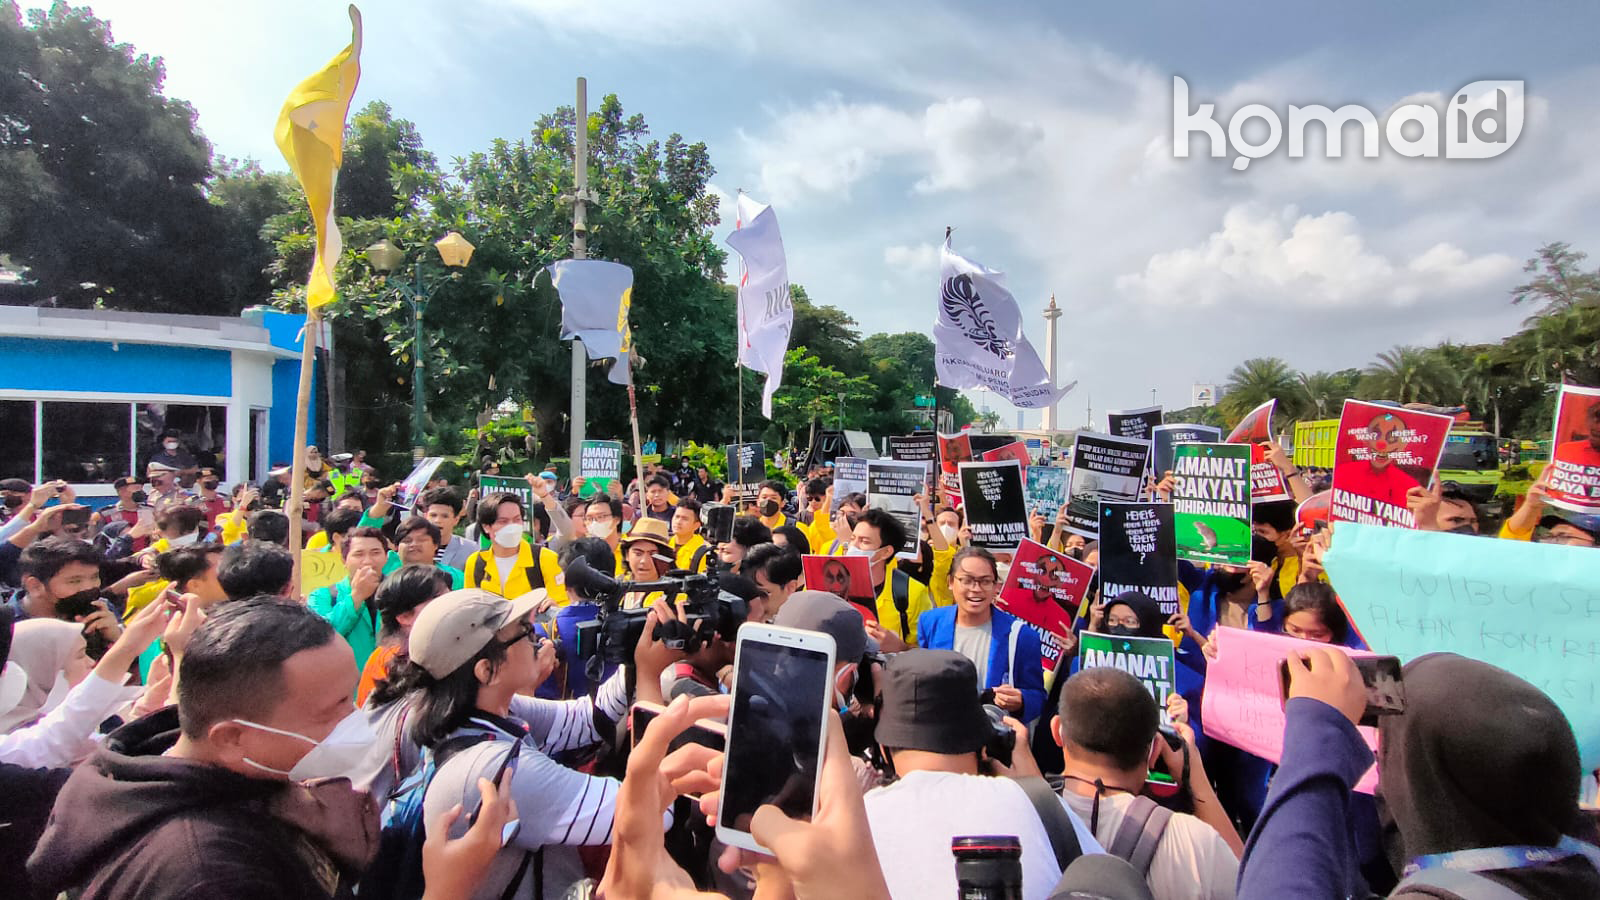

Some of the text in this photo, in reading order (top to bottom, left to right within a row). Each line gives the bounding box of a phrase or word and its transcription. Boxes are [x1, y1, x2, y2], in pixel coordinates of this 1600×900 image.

[582, 448, 618, 458] AMANAT
[582, 459, 617, 469] RAKYAT
[1175, 456, 1246, 478] AMANAT
[1174, 477, 1246, 501] RAKYAT
[1551, 479, 1587, 496] GAYA
[1126, 509, 1156, 520] HEHEHE
[1174, 499, 1247, 519] DIHIRAUKAN
[1332, 504, 1356, 520] MAU
[1333, 488, 1416, 528] KAMU YAKIN
[970, 522, 1025, 534] KAMU YAKIN
[972, 533, 987, 542] MAU
[988, 533, 1006, 542] HINA
[1129, 535, 1156, 544] HEHEHE
[1130, 543, 1155, 552] YAKIN
[1140, 552, 1146, 565] ?
[1142, 586, 1177, 601] YAKIN
[1400, 568, 1536, 608] WIBU
[1157, 602, 1178, 615] KU?
[1368, 603, 1455, 640] AKAN
[1040, 648, 1059, 661] KU?
[1083, 648, 1169, 679] AMANAT
